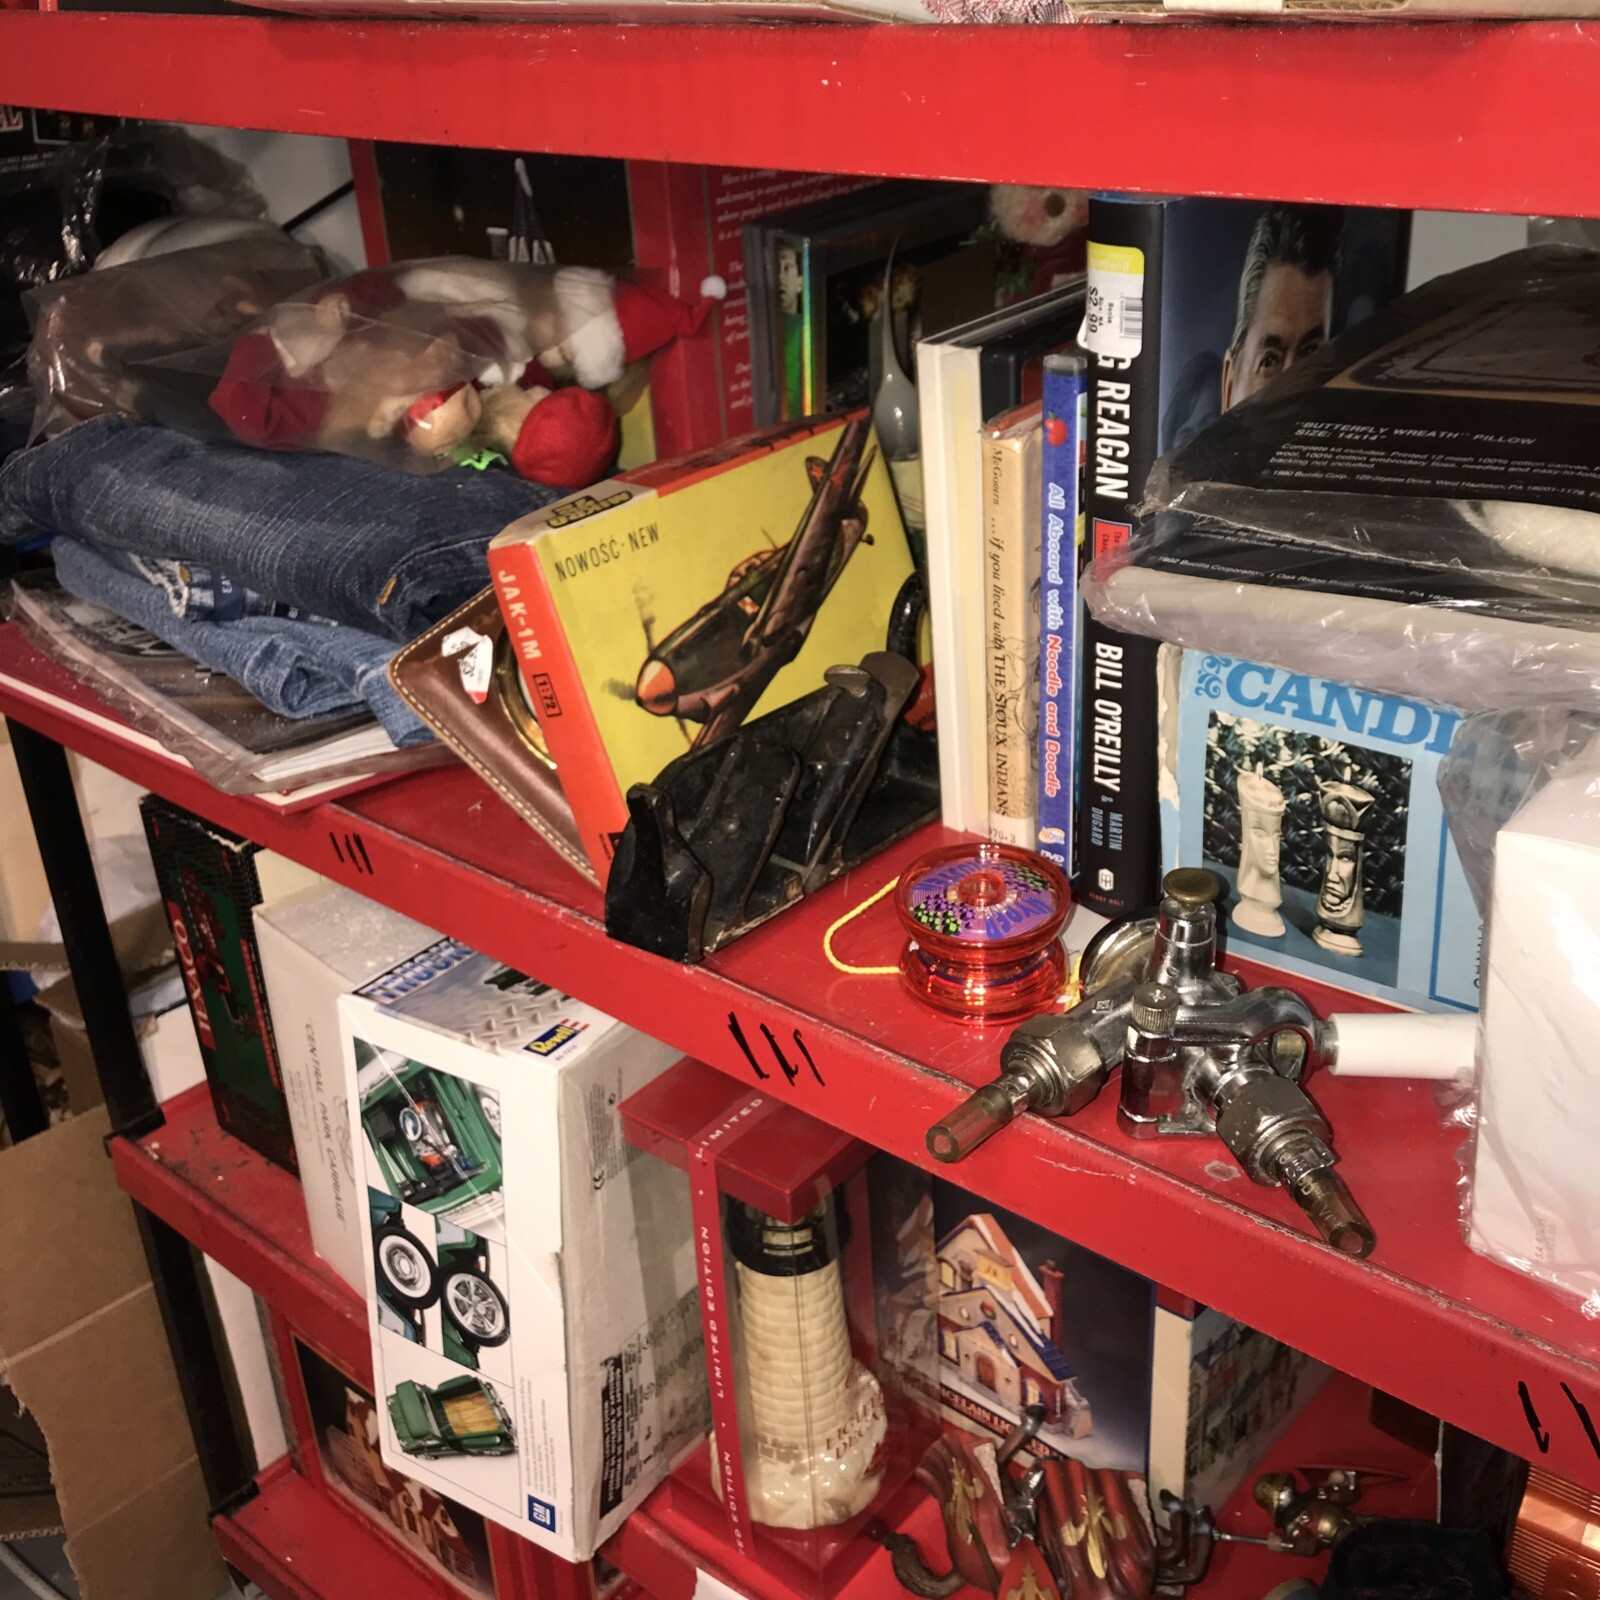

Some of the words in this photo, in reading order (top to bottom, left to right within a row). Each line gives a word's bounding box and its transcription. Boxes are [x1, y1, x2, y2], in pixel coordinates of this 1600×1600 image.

[1089, 286, 1099, 333] $2.99
[1095, 379, 1131, 500] REAGAN
[1294, 429, 1332, 438] SIZE:
[1472, 433, 1537, 445] PILLOW
[1269, 457, 1309, 466] backing
[1281, 443, 1328, 453] Complete
[1389, 451, 1429, 460] Printed
[1445, 455, 1474, 463] mesh
[1478, 457, 1509, 465] 100%
[1511, 459, 1545, 468] cotton
[1305, 452, 1333, 460] 100%
[1335, 454, 1367, 462] cotton
[1369, 457, 1429, 467] embroidery
[1462, 463, 1505, 471] needles
[993, 448, 1003, 505] McGovern
[1049, 482, 1065, 509] All
[554, 534, 620, 582] NOWOŚĆ
[628, 522, 660, 552] NEW
[989, 552, 1003, 580] you
[1048, 513, 1064, 585] Aboard
[498, 570, 542, 660] JAK-1M
[993, 585, 1005, 618] lived
[1047, 589, 1064, 630] with
[993, 621, 1005, 651] with
[994, 654, 1007, 688] THE
[1046, 634, 1063, 697] Noodle
[1094, 641, 1124, 690] BILL
[538, 679, 556, 709] 1:72
[995, 692, 1008, 746] SIOUX
[1045, 701, 1061, 738] and
[1093, 698, 1122, 792] O'REILLY
[996, 752, 1009, 817] INDIANS
[1045, 739, 1061, 797] Doodle
[1091, 806, 1104, 847] DUGARD
[1108, 811, 1122, 850] MARTIN
[174, 918, 211, 1031] TEXACO
[529, 1025, 576, 1055] Revell
[319, 1101, 332, 1139] PARK
[695, 1098, 764, 1159] LIMITED
[700, 1226, 716, 1312] EDITION
[709, 1319, 724, 1399] LIMITED
[723, 1452, 740, 1523] EDITION
[552, 1502, 571, 1525] GM
